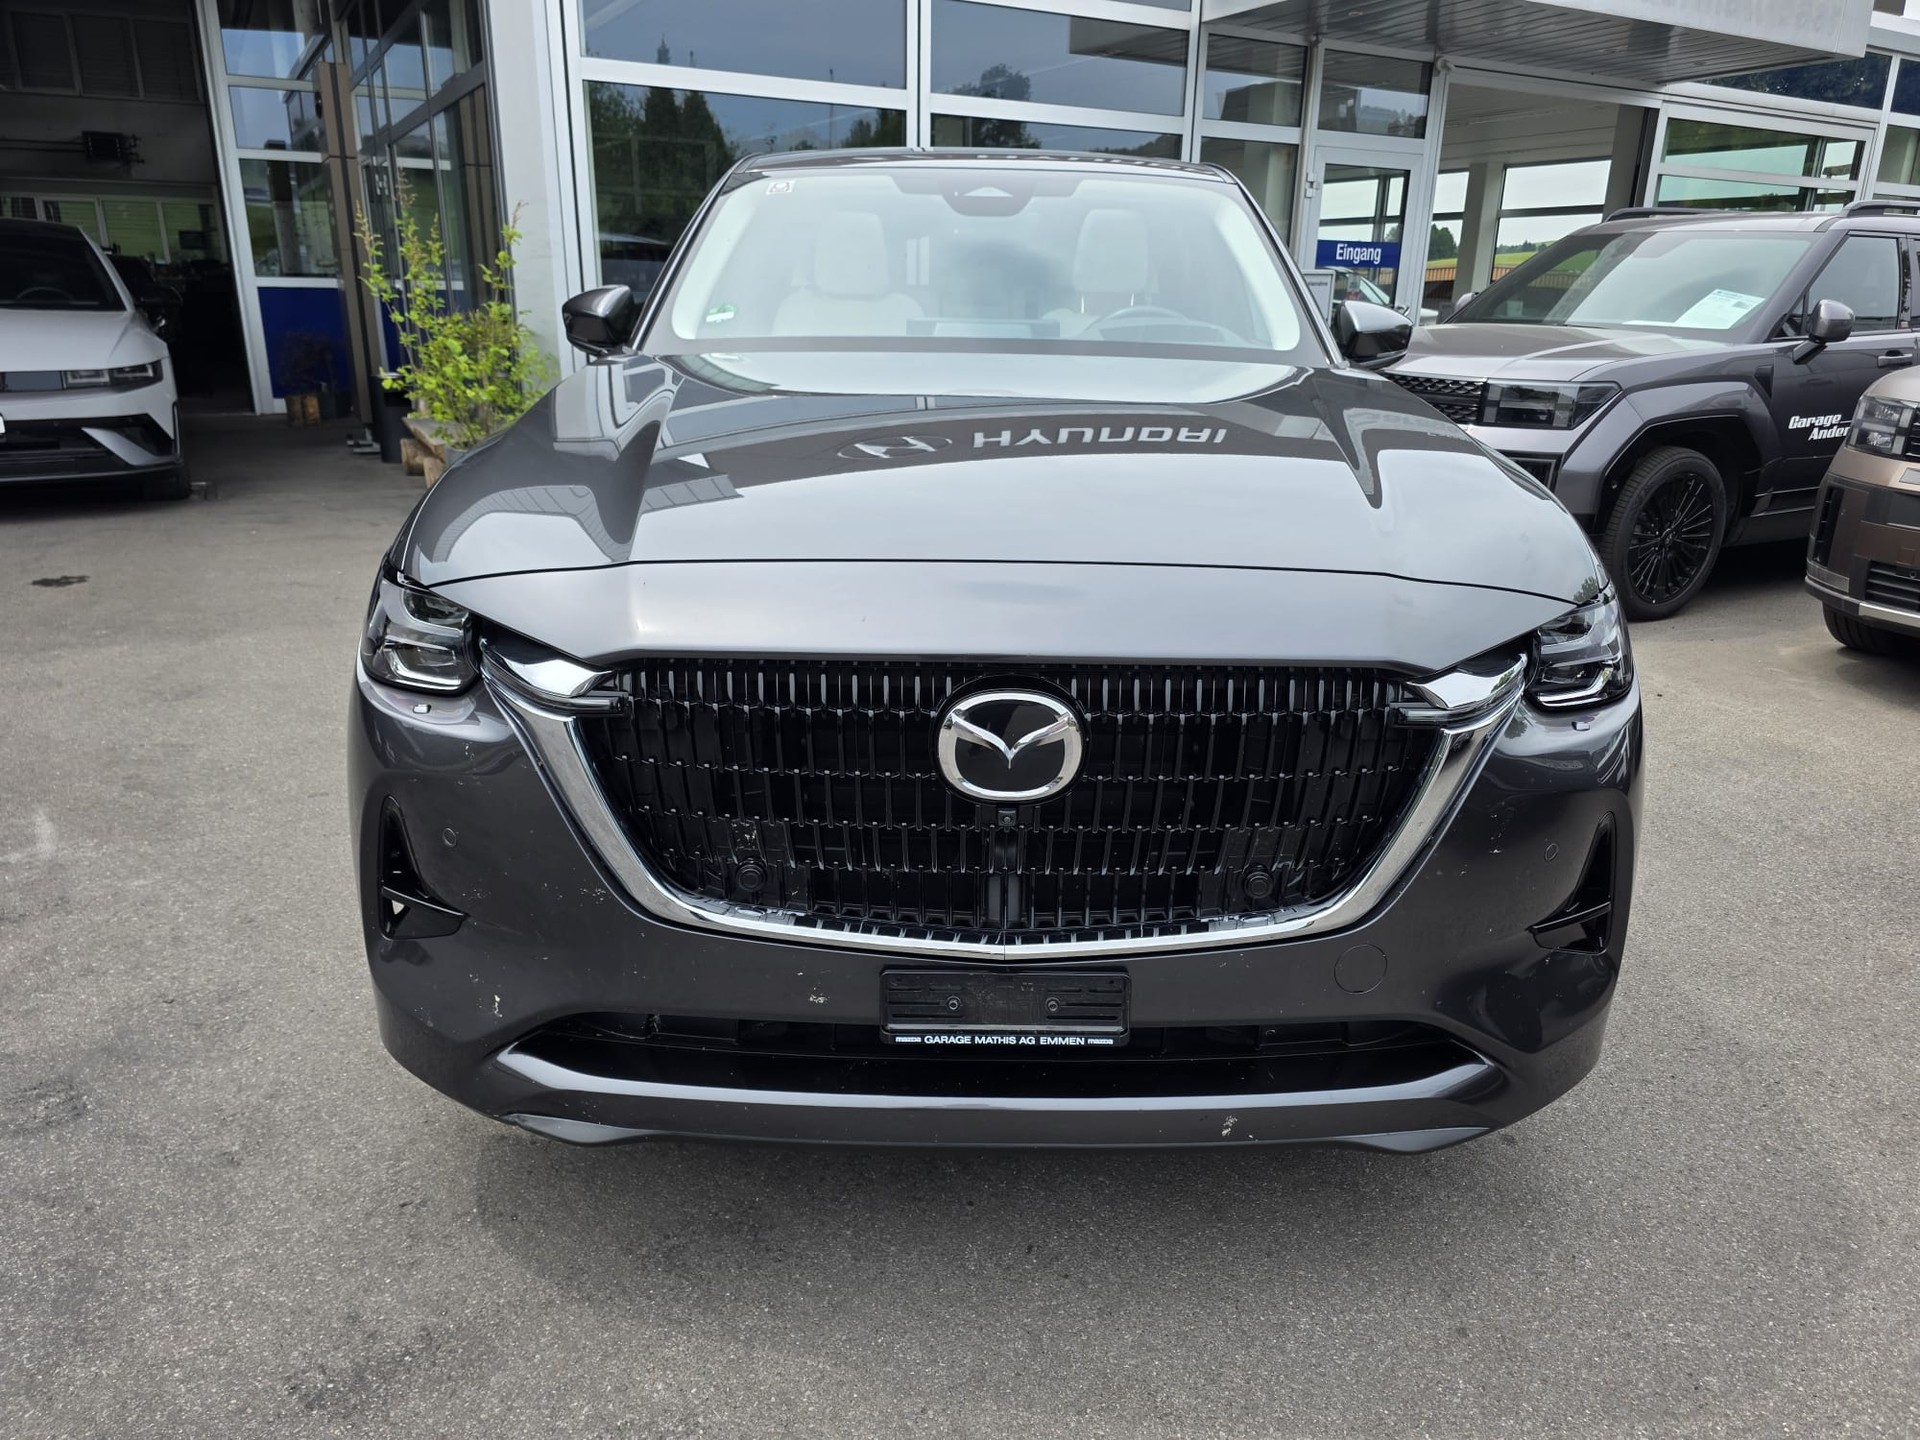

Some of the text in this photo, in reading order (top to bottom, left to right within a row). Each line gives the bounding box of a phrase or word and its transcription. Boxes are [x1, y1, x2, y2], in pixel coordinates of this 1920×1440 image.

[1336, 243, 1382, 264] Eingang
[1788, 414, 1842, 429] Garage
[924, 1035, 971, 1044] GARAGE
[974, 1036, 1017, 1045] MATHIS
[1019, 1036, 1036, 1045] AG
[1039, 1036, 1085, 1045] EMMEN
